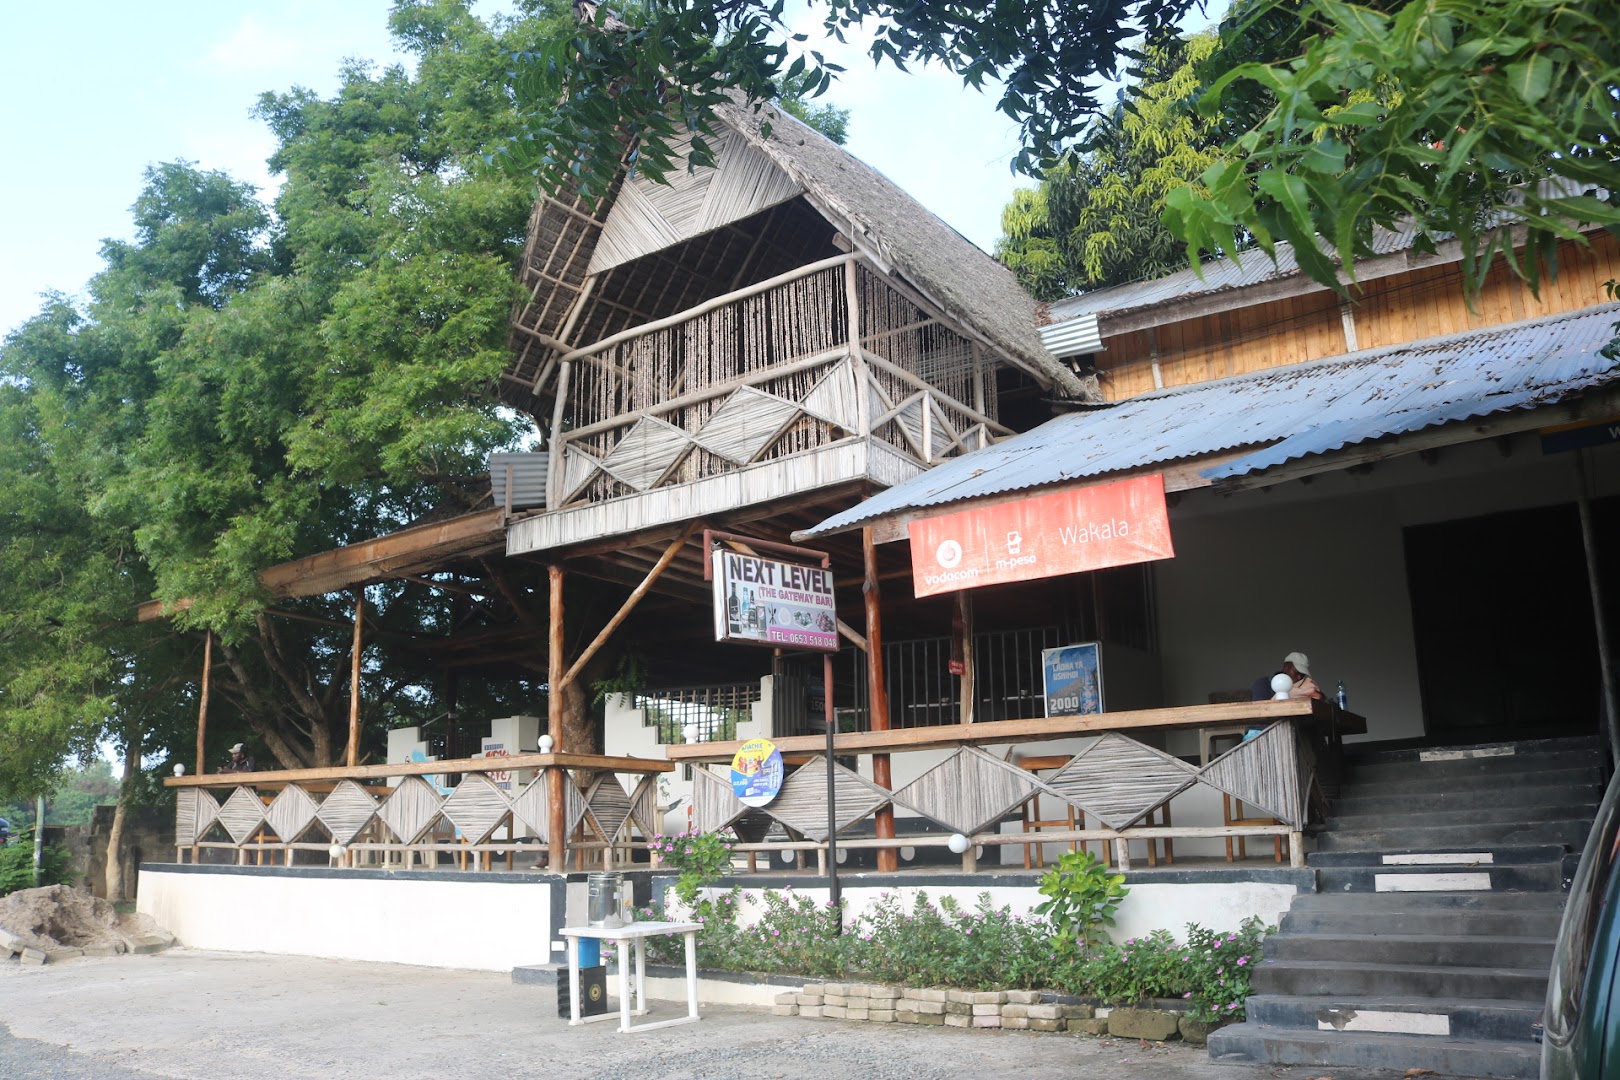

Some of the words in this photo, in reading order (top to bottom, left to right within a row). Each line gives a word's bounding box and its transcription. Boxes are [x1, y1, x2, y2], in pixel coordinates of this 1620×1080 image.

[1059, 518, 1129, 546] Wakala
[996, 554, 1036, 570] m-pesa
[729, 555, 775, 585] NEXT
[780, 564, 832, 594] LEVEL
[925, 567, 978, 586] vodacom
[758, 586, 777, 599] (THE
[778, 589, 814, 604] GATEWAY
[815, 595, 833, 608] BAR)
[771, 630, 788, 642] TEL:
[789, 633, 807, 645] 0653
[809, 635, 822, 646] 518
[824, 638, 837, 648] 048
[1050, 697, 1078, 710] 2000
